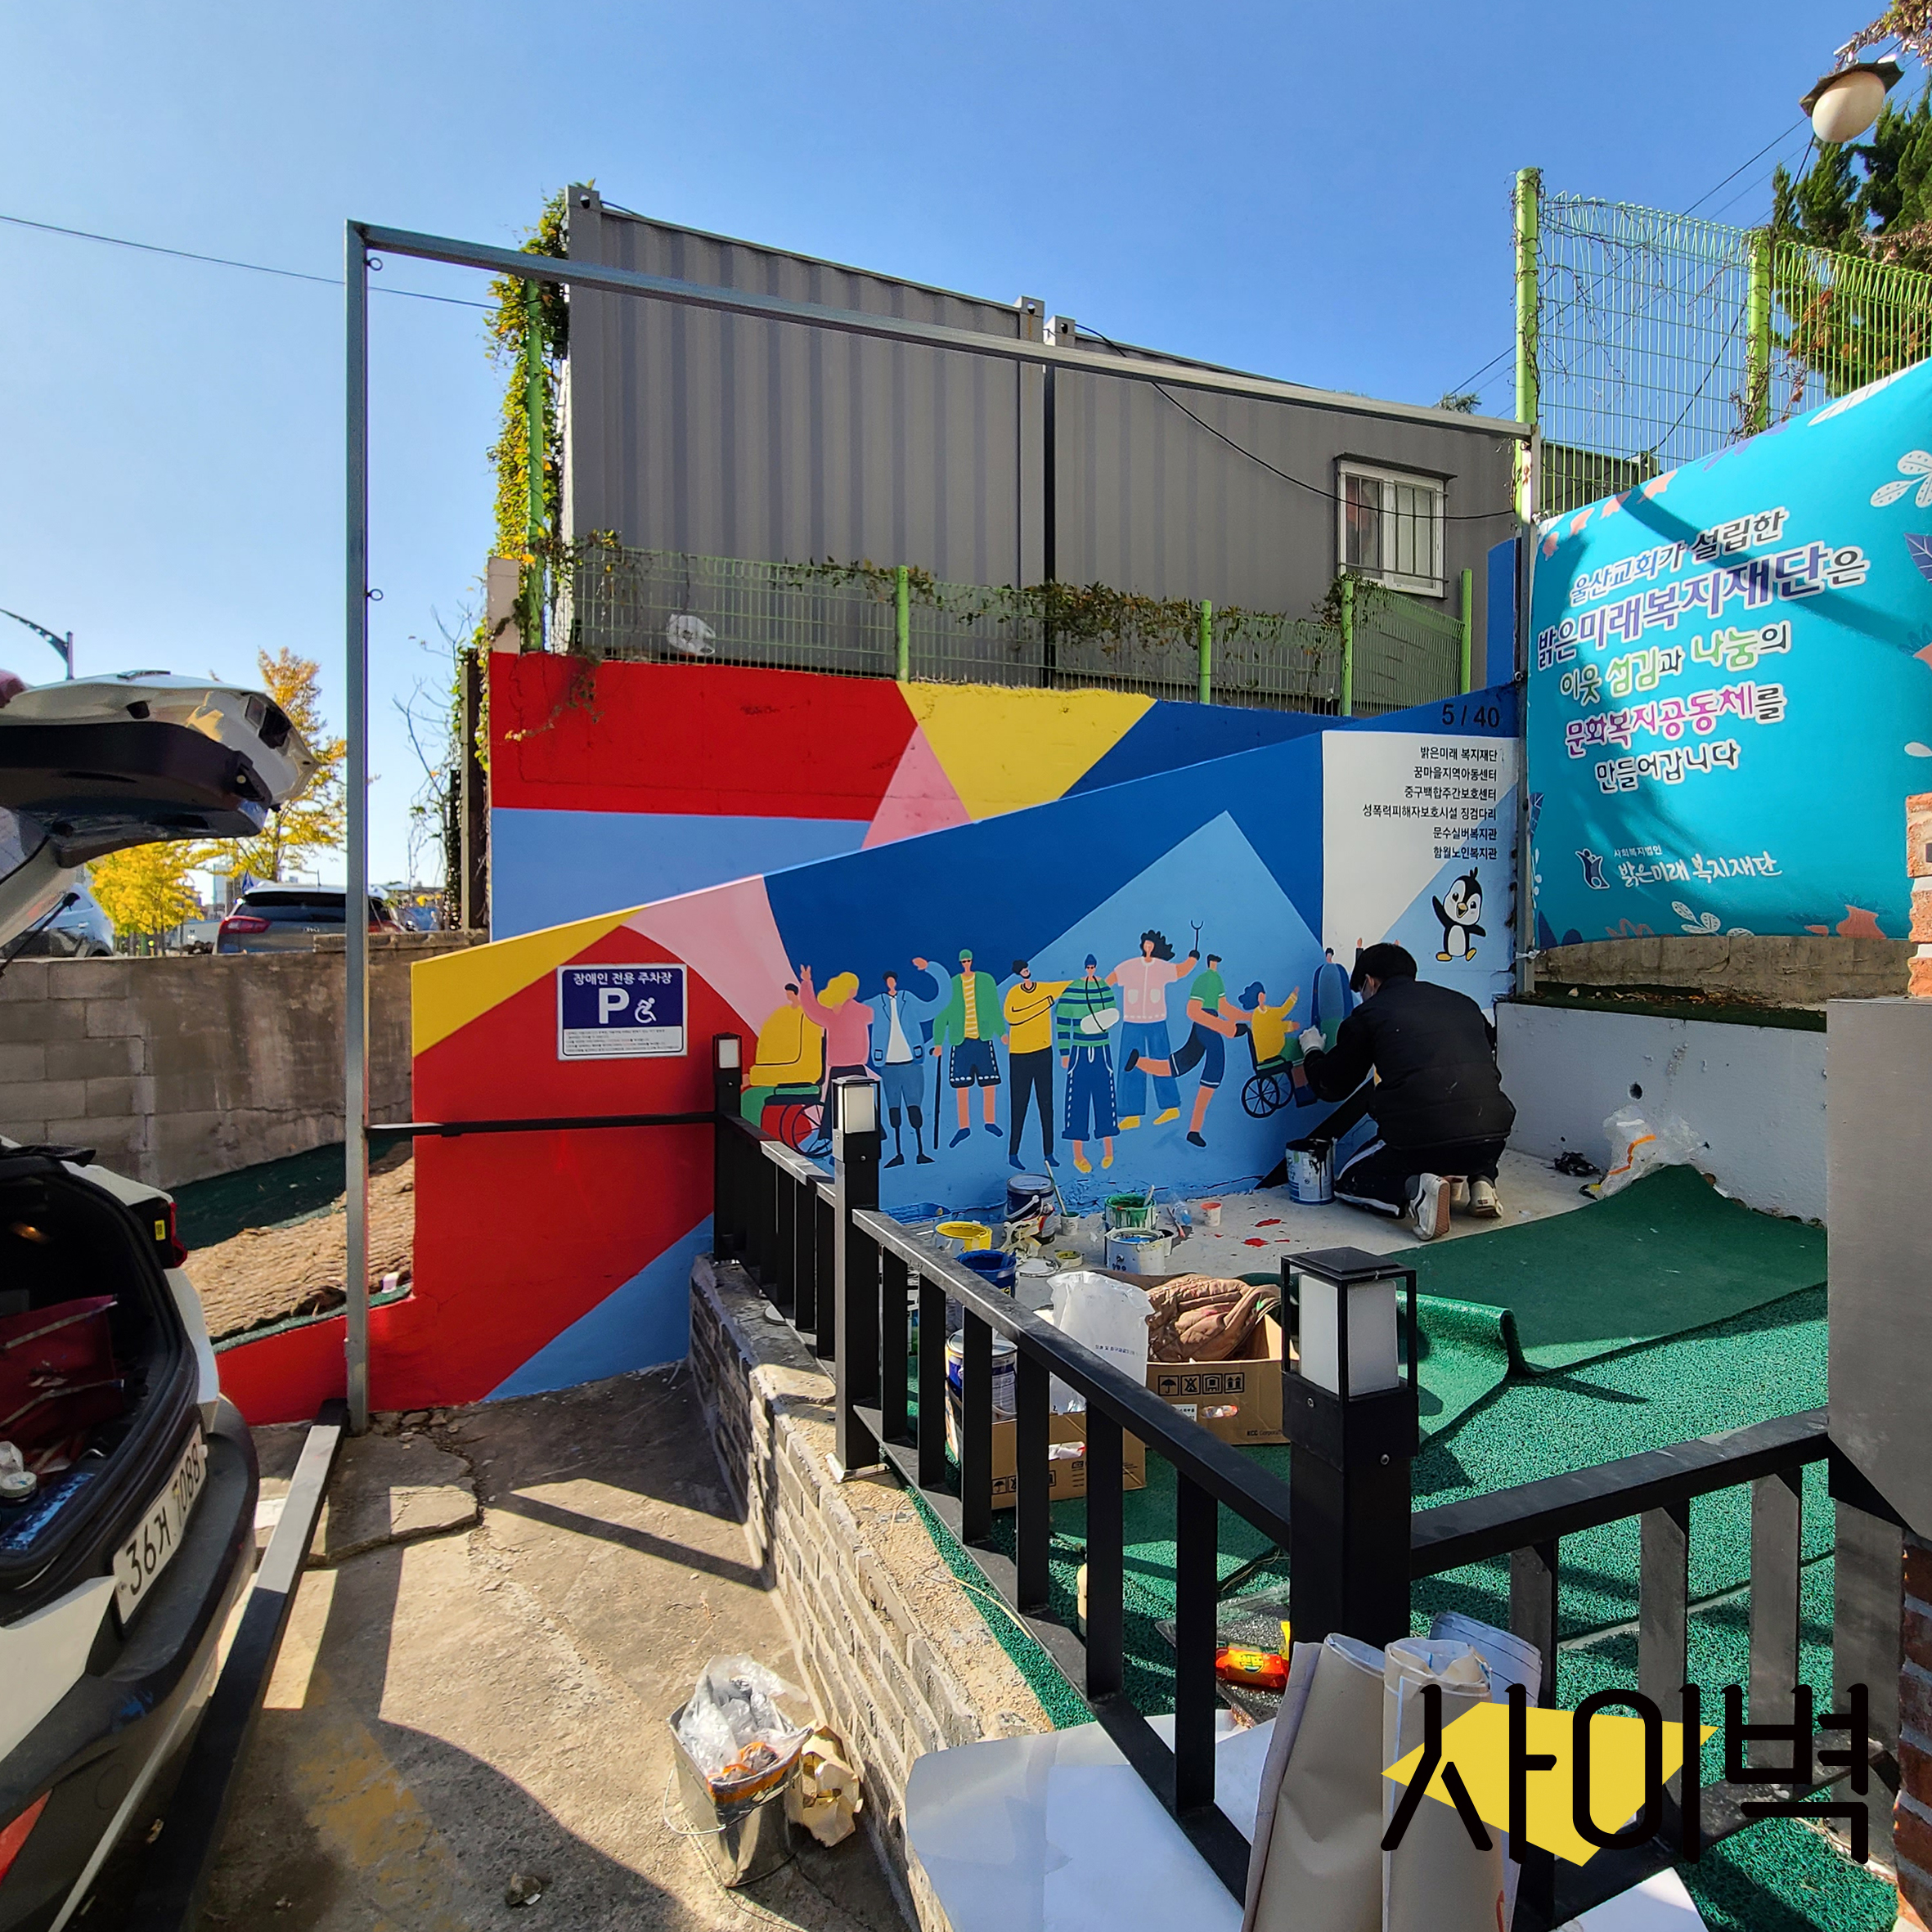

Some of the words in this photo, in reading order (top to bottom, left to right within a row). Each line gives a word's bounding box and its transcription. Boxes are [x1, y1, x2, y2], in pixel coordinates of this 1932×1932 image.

[1570, 539, 1686, 604] 울산교회가
[1692, 510, 1786, 559] 설립한
[1538, 546, 1867, 670] 밝은미래복지재단은
[1561, 667, 1600, 703] 이웃
[1606, 649, 1683, 695] 섬김과
[1693, 622, 1790, 670] 나눔의
[1441, 703, 1454, 726] 5
[1473, 706, 1500, 728] 40
[1566, 685, 1786, 757] 문화복지공동체를
[1420, 746, 1458, 761] 밝은미래
[1461, 748, 1498, 762] 복지재단
[1597, 741, 1740, 791] 만들어갑니다
[1413, 766, 1497, 782] 꿈마을지역아동센터
[1404, 785, 1497, 802] 중구백합주간보호센터
[1363, 804, 1458, 820] 성폭력피해자보호시설
[1461, 806, 1497, 821] 징검다리
[1433, 826, 1498, 841] 문수실버복지관
[1433, 846, 1498, 860] 함월노인복지관
[1614, 845, 1663, 858] 사회복지법인
[1618, 859, 1691, 887] 밝은미래
[1691, 851, 1783, 883] 복지재단
[573, 972, 609, 986] 장애인
[612, 971, 636, 985] 전용
[638, 971, 673, 985] 주차장
[599, 987, 630, 1024] P
[126, 1506, 171, 1596] 36거
[172, 1443, 200, 1528] 7088
